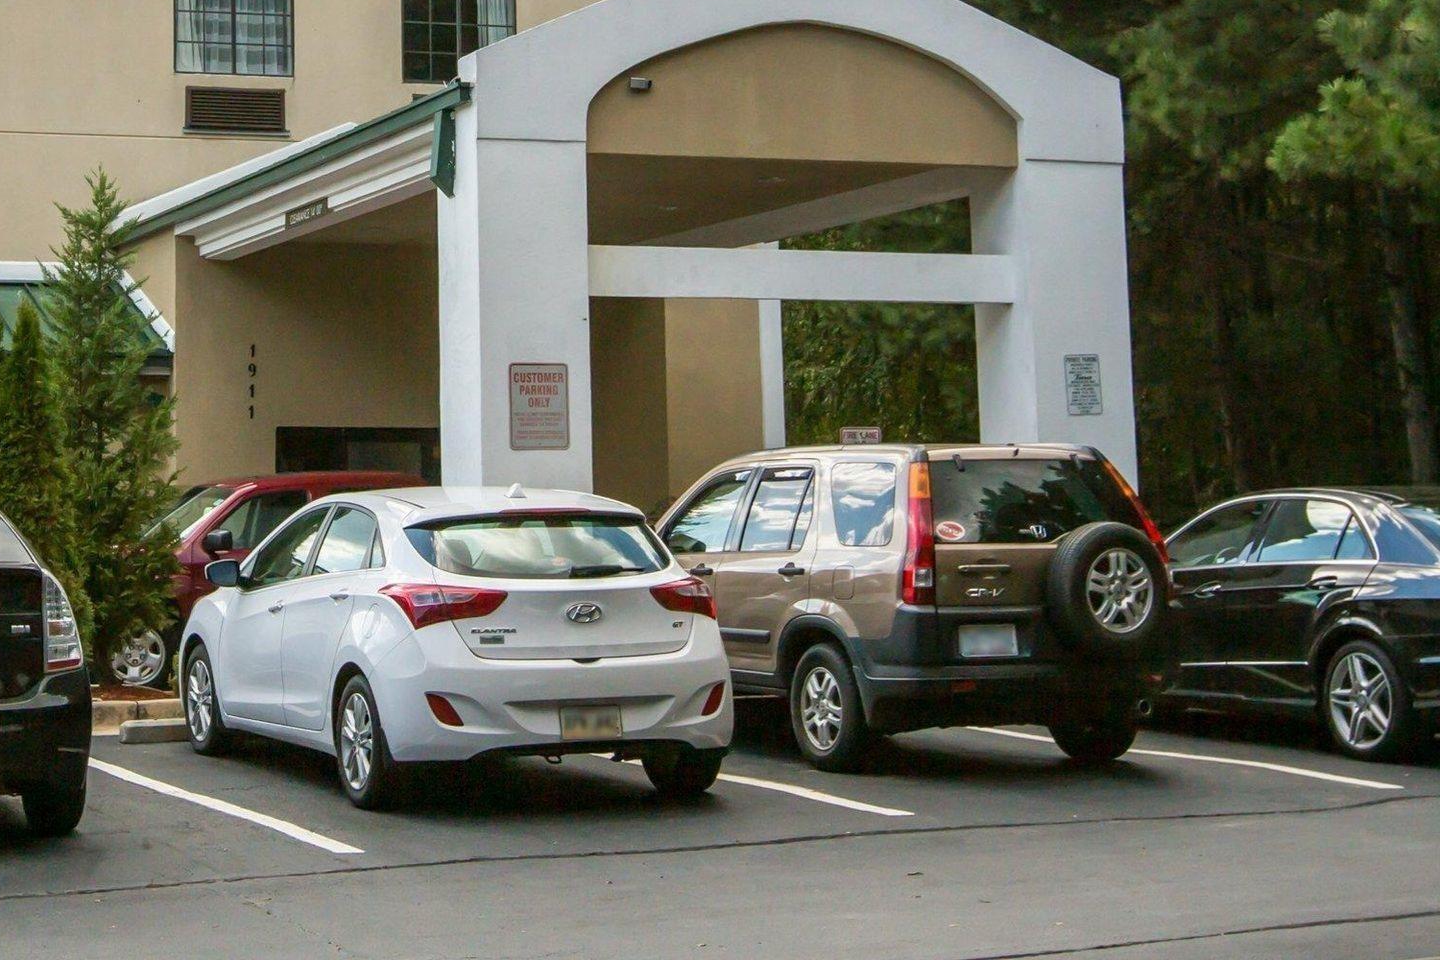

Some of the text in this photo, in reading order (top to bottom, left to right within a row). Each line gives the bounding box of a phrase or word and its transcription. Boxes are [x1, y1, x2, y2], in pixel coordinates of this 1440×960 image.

[247, 343, 257, 419] 1911
[513, 372, 565, 384] CUSTOMER
[519, 385, 560, 396] PARKING
[527, 397, 552, 408] ONLY
